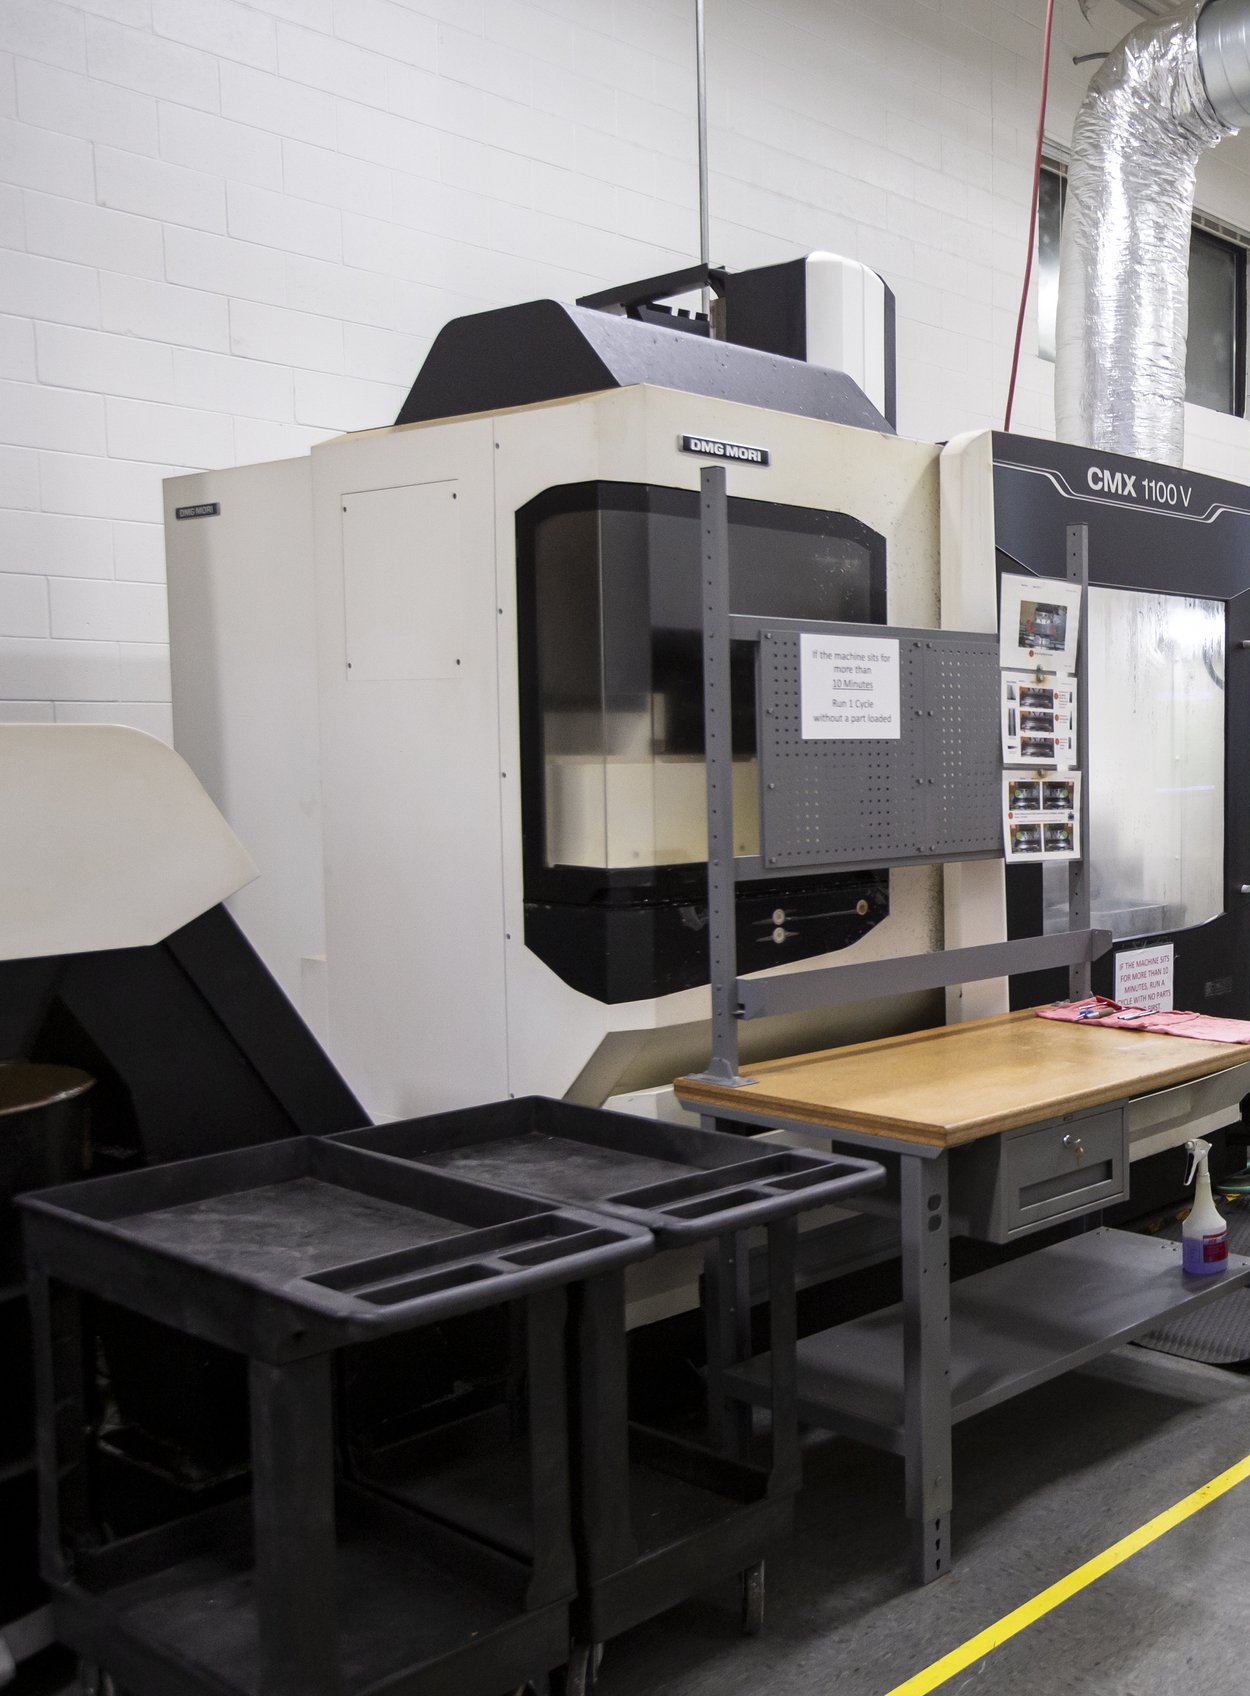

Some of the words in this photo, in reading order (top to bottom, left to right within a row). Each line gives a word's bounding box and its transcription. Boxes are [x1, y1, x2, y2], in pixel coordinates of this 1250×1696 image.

[690, 439, 724, 455] DMG
[725, 446, 761, 462] MORI
[1087, 466, 1137, 498] CMX
[1142, 478, 1177, 506] 1100
[1179, 485, 1192, 507] V
[820, 650, 833, 660] the
[834, 652, 866, 662] machine
[867, 653, 879, 662] sits
[881, 653, 891, 662] for
[833, 666, 853, 674] more
[855, 665, 872, 674] than
[832, 679, 842, 688] 10
[844, 679, 874, 689] Minutes
[832, 699, 847, 708] Run
[849, 699, 853, 708] 1
[855, 699, 874, 709] Cycle
[813, 713, 843, 723] without
[851, 714, 866, 724] part
[868, 713, 892, 723] loaded
[1125, 961, 1135, 969] THE
[1136, 957, 1159, 967] MACHINE
[1160, 955, 1170, 963] SITS
[1120, 974, 1131, 983] FOR
[1132, 971, 1147, 980] MORE
[1148, 969, 1162, 977] THAN
[1150, 980, 1161, 988] RUN
[1133, 994, 1147, 1003] WITH
[1156, 989, 1171, 999] PARTS
